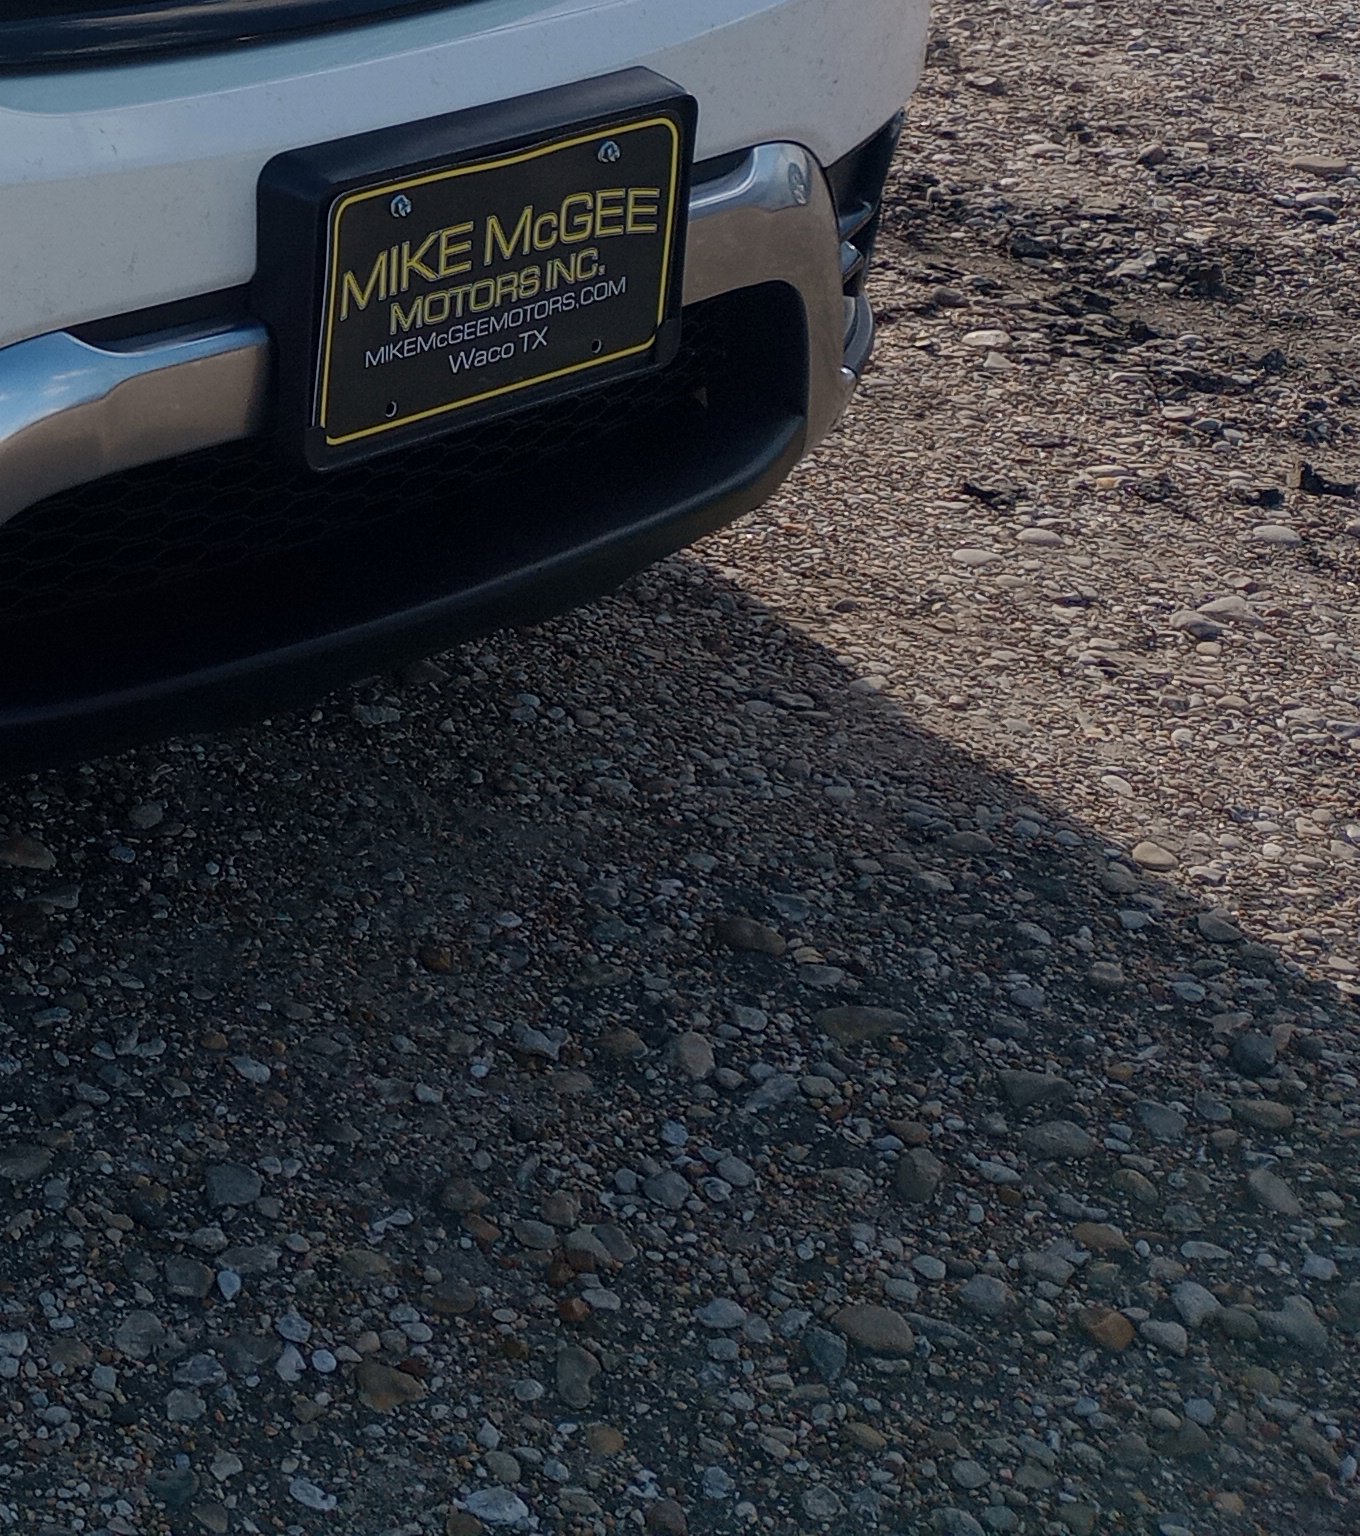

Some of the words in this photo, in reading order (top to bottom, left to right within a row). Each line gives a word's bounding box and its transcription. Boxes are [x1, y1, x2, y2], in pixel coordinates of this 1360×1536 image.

[340, 220, 474, 322] MIKE
[483, 187, 661, 266] McGEE
[390, 269, 542, 335] MOTORS
[545, 247, 607, 293] INC.
[364, 276, 627, 368] MIKEMcGEEMOTORS.COM
[448, 341, 515, 374] Waco
[519, 326, 549, 352] TX
